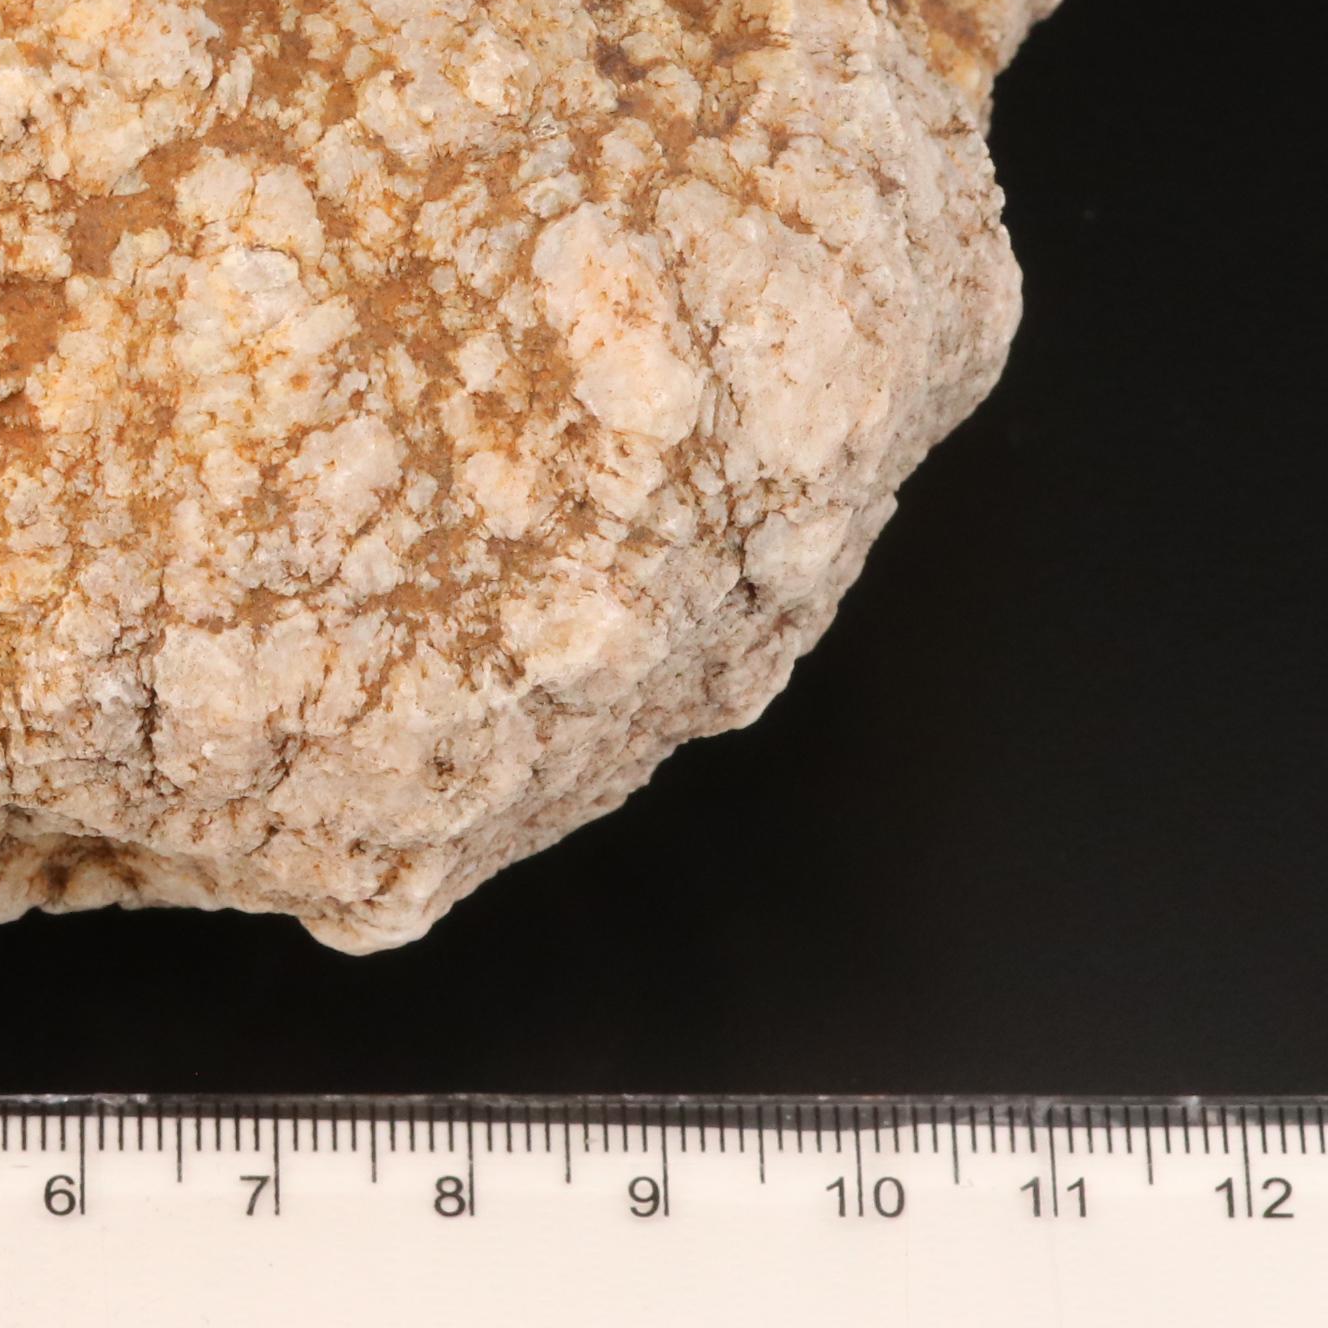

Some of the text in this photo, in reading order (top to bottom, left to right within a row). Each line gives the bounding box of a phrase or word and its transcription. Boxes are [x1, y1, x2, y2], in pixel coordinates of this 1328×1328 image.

[43, 1174, 77, 1217] 6
[240, 1175, 270, 1216] 7
[433, 1175, 467, 1218] 8
[628, 1176, 660, 1218] 9
[826, 1177, 905, 1218] 10
[1020, 1177, 1086, 1218] 11
[1215, 1177, 1294, 1219] 12
